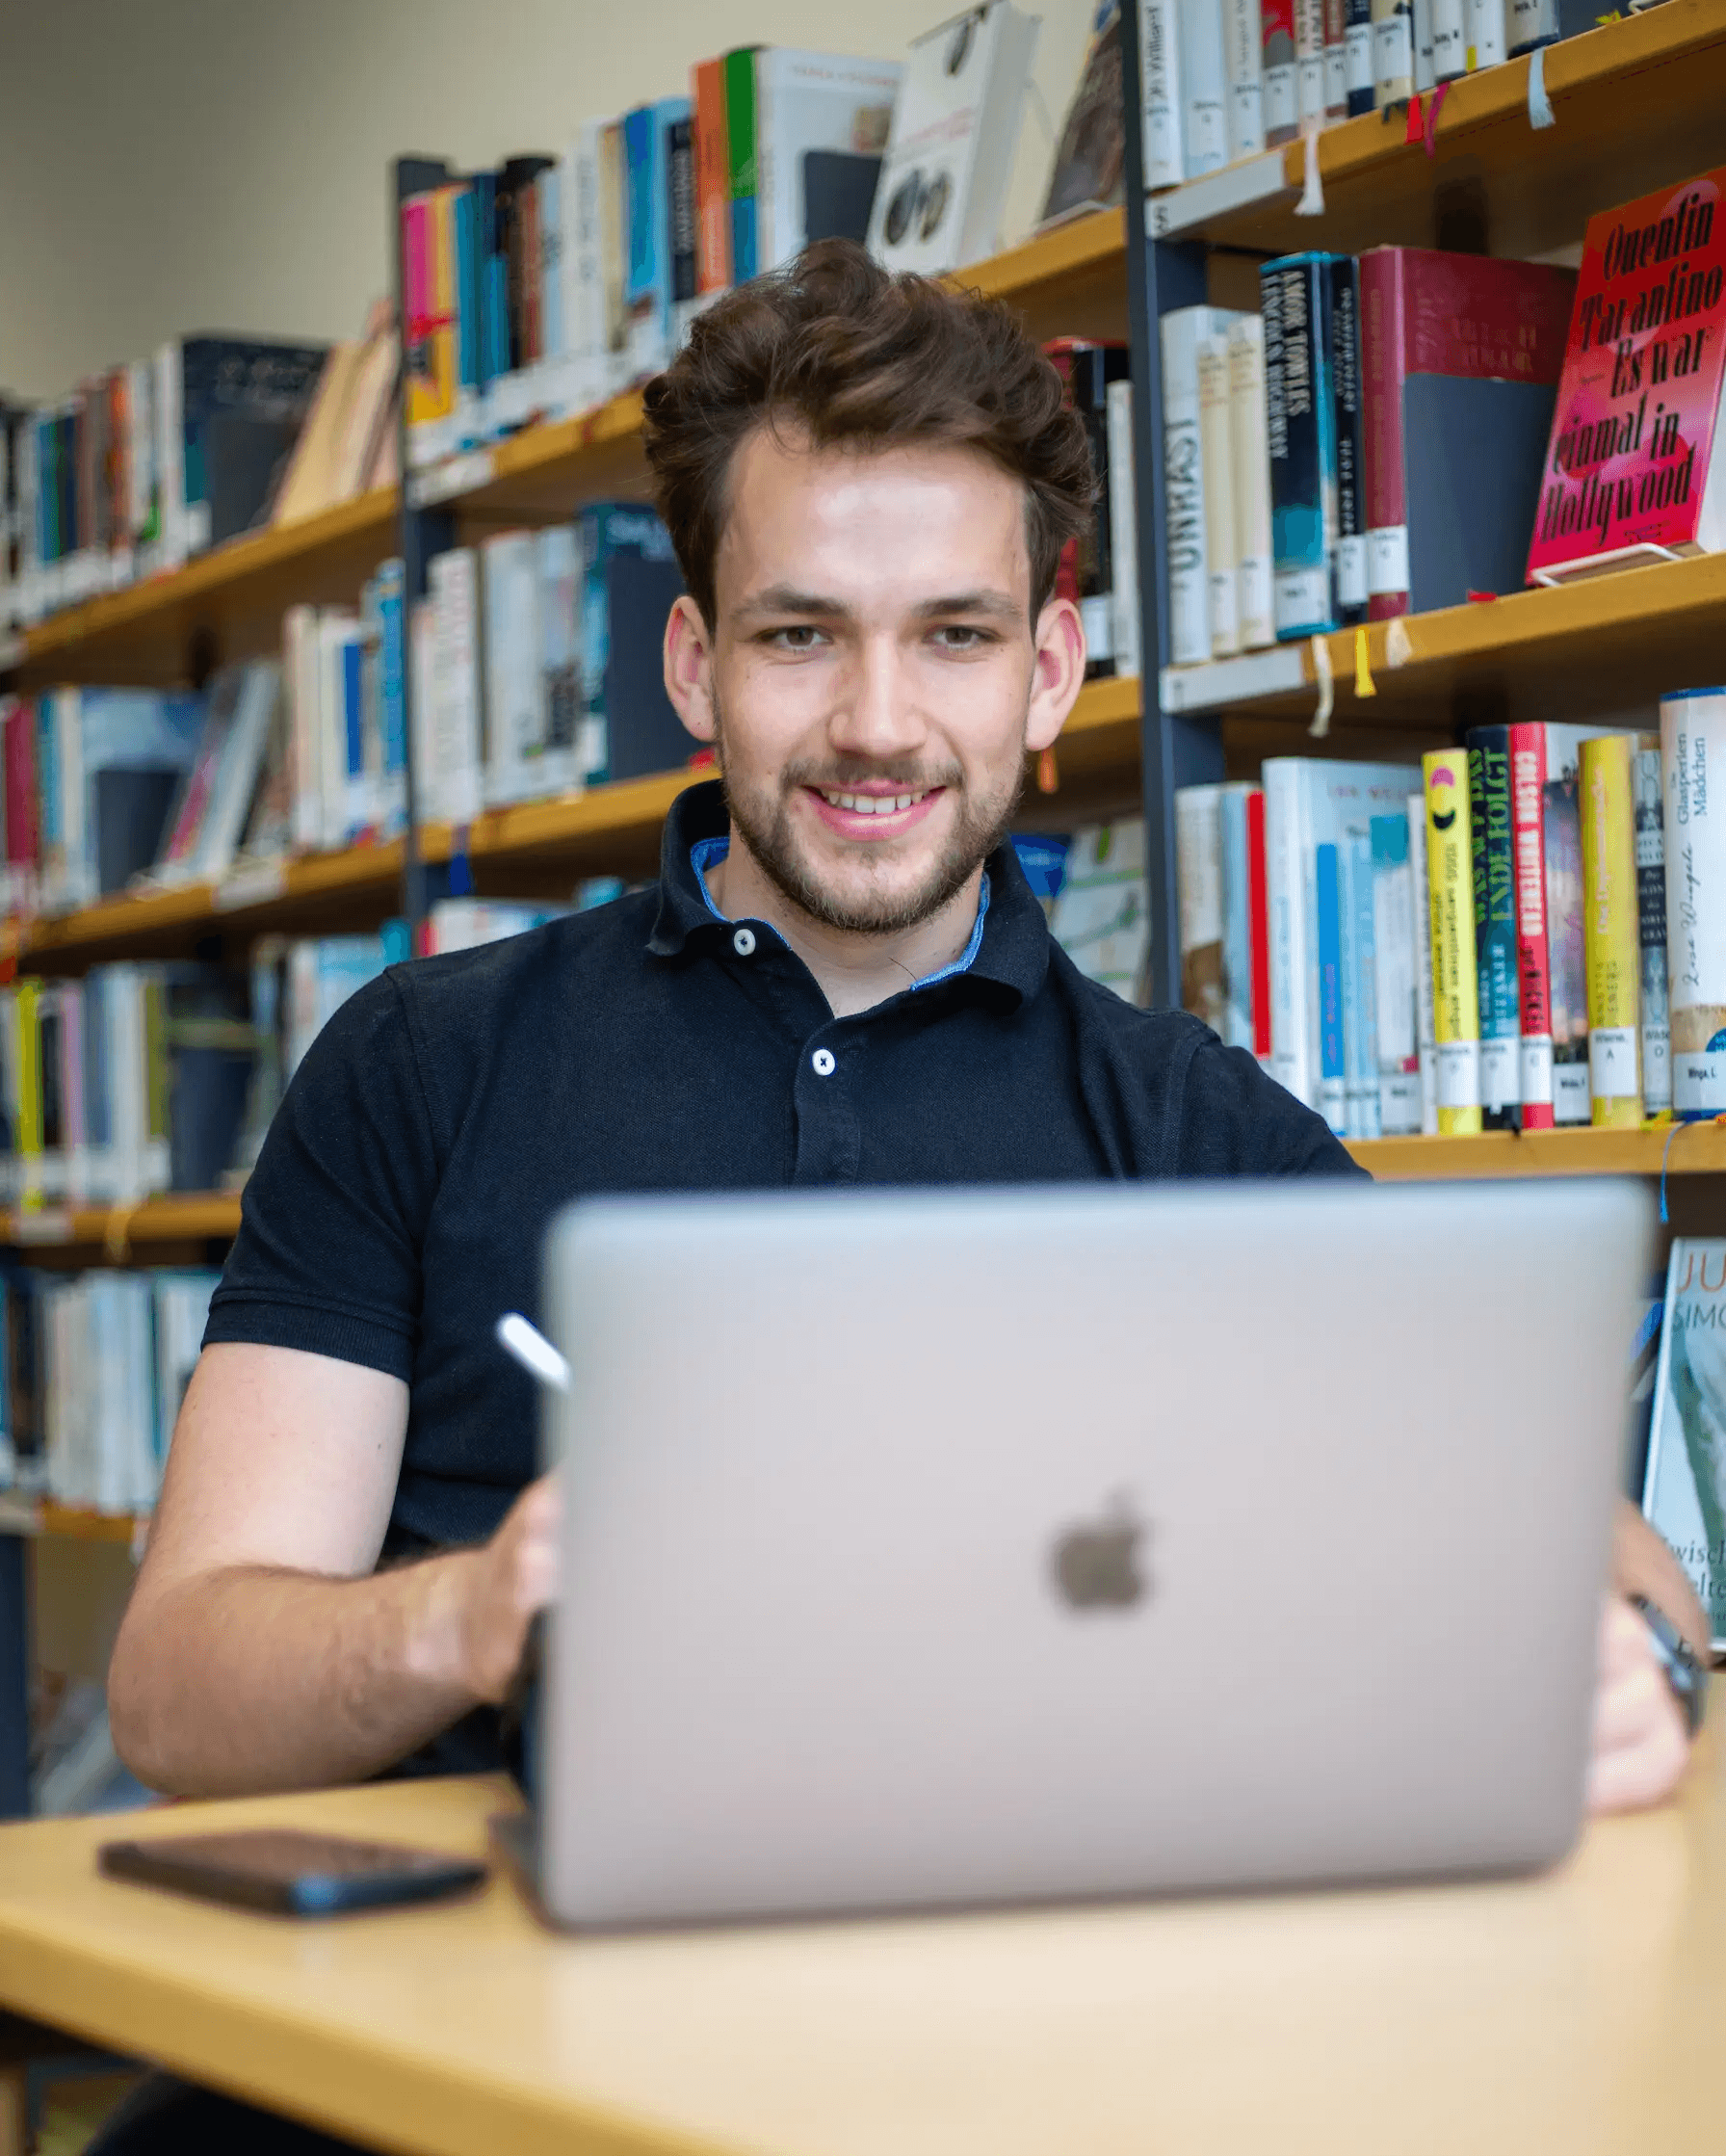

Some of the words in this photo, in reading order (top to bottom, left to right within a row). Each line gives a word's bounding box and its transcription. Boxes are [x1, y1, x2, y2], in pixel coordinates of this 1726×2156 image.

[1604, 193, 1715, 281] Quentin
[1580, 260, 1724, 353] Tarantino
[1610, 336, 1645, 398] Es
[1652, 328, 1708, 386] war
[1554, 390, 1650, 474] einmal
[1650, 402, 1680, 460] in
[1541, 440, 1698, 546] Hollywood
[1675, 733, 1690, 826] Glasperlen
[1692, 737, 1708, 817] Mädchen
